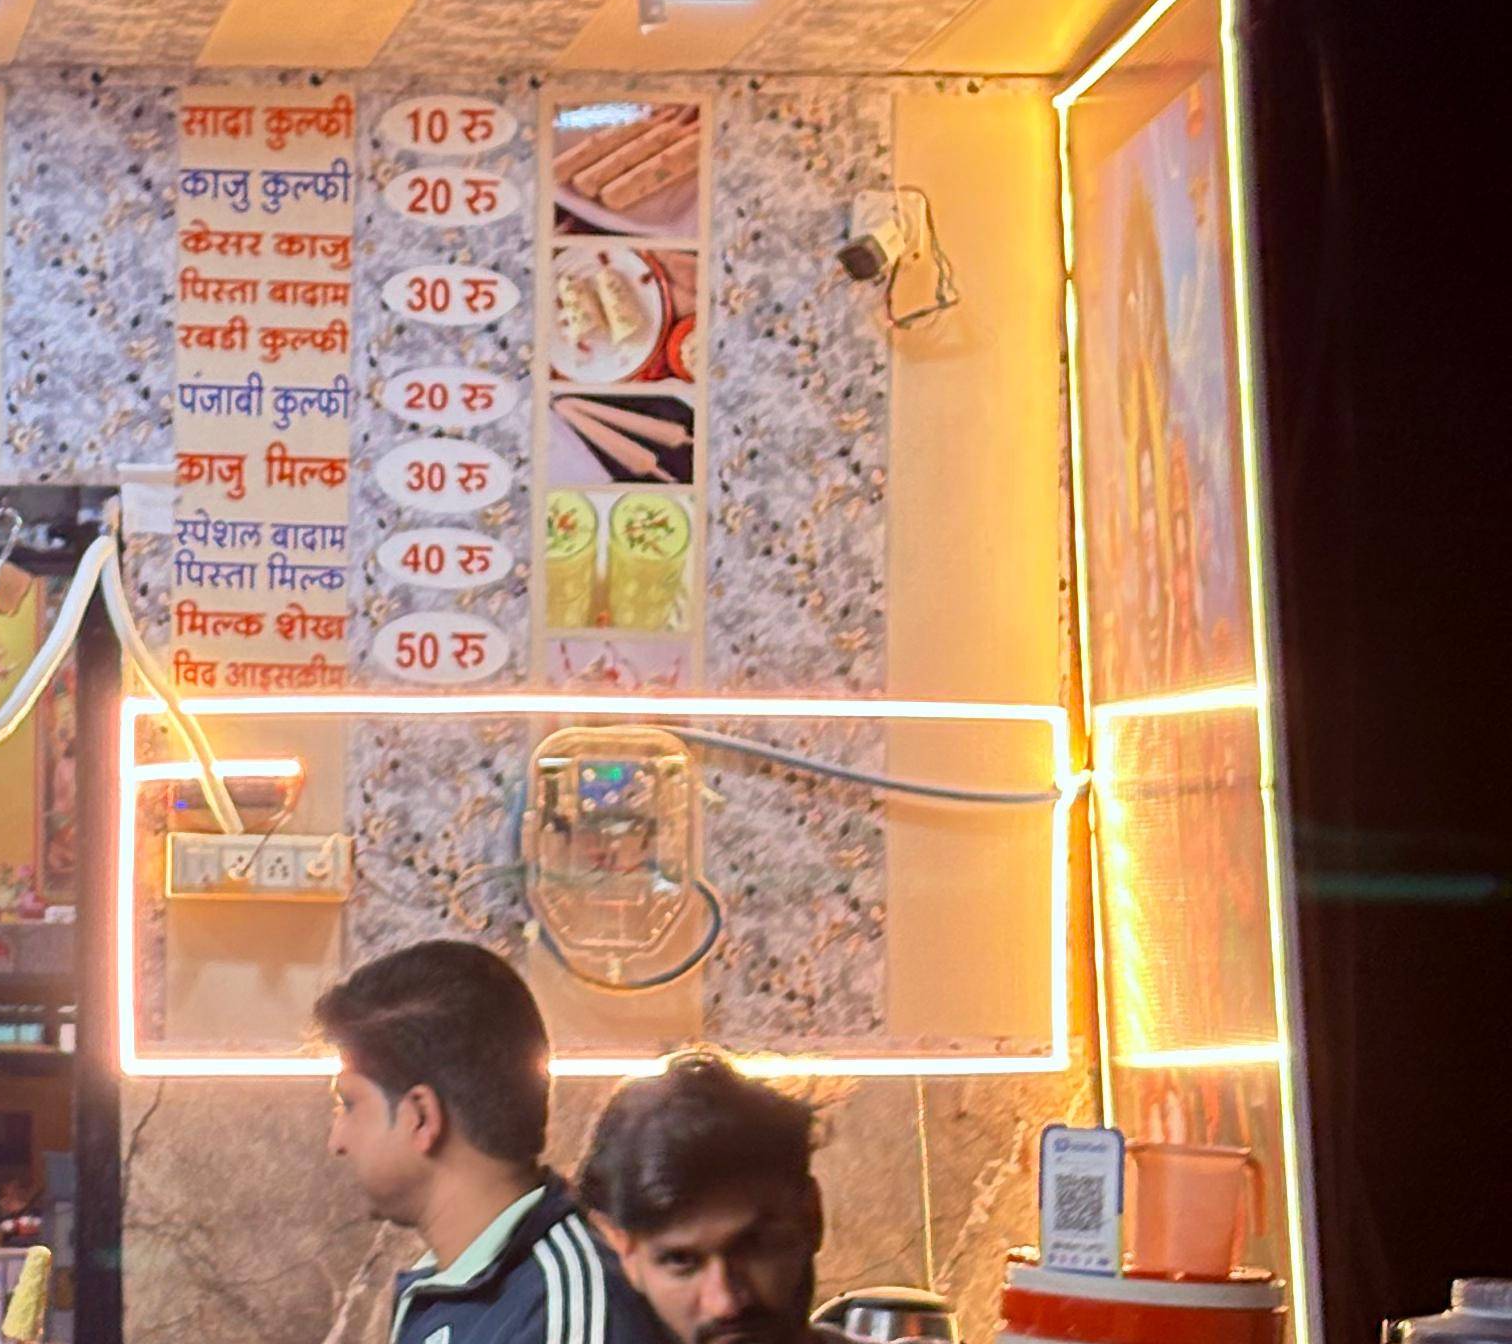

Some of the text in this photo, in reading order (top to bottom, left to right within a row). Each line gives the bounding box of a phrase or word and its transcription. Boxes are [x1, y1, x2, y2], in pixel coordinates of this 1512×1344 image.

[180, 94, 353, 150] सादा कुल्फी
[407, 108, 496, 145] 10 रु
[180, 158, 352, 213] काजु कुल्फी
[407, 176, 500, 216] 20 रु
[179, 218, 353, 271] केसर काजु
[180, 266, 351, 306] पिस्ता बादाम
[406, 277, 498, 314] 30 रु
[259, 318, 350, 363] कुल्फी
[178, 370, 350, 430] पंजाबी कुल्फी
[404, 382, 496, 412] 20 रु
[174, 441, 349, 500] काजु मिल्क
[406, 461, 489, 493] 30 रु
[175, 508, 264, 548] स्पेशल
[174, 549, 347, 590] पिस्ता मिल्क
[400, 543, 493, 575] 40 रु
[175, 600, 267, 637] मिल्क
[395, 632, 488, 669] 50 रु
